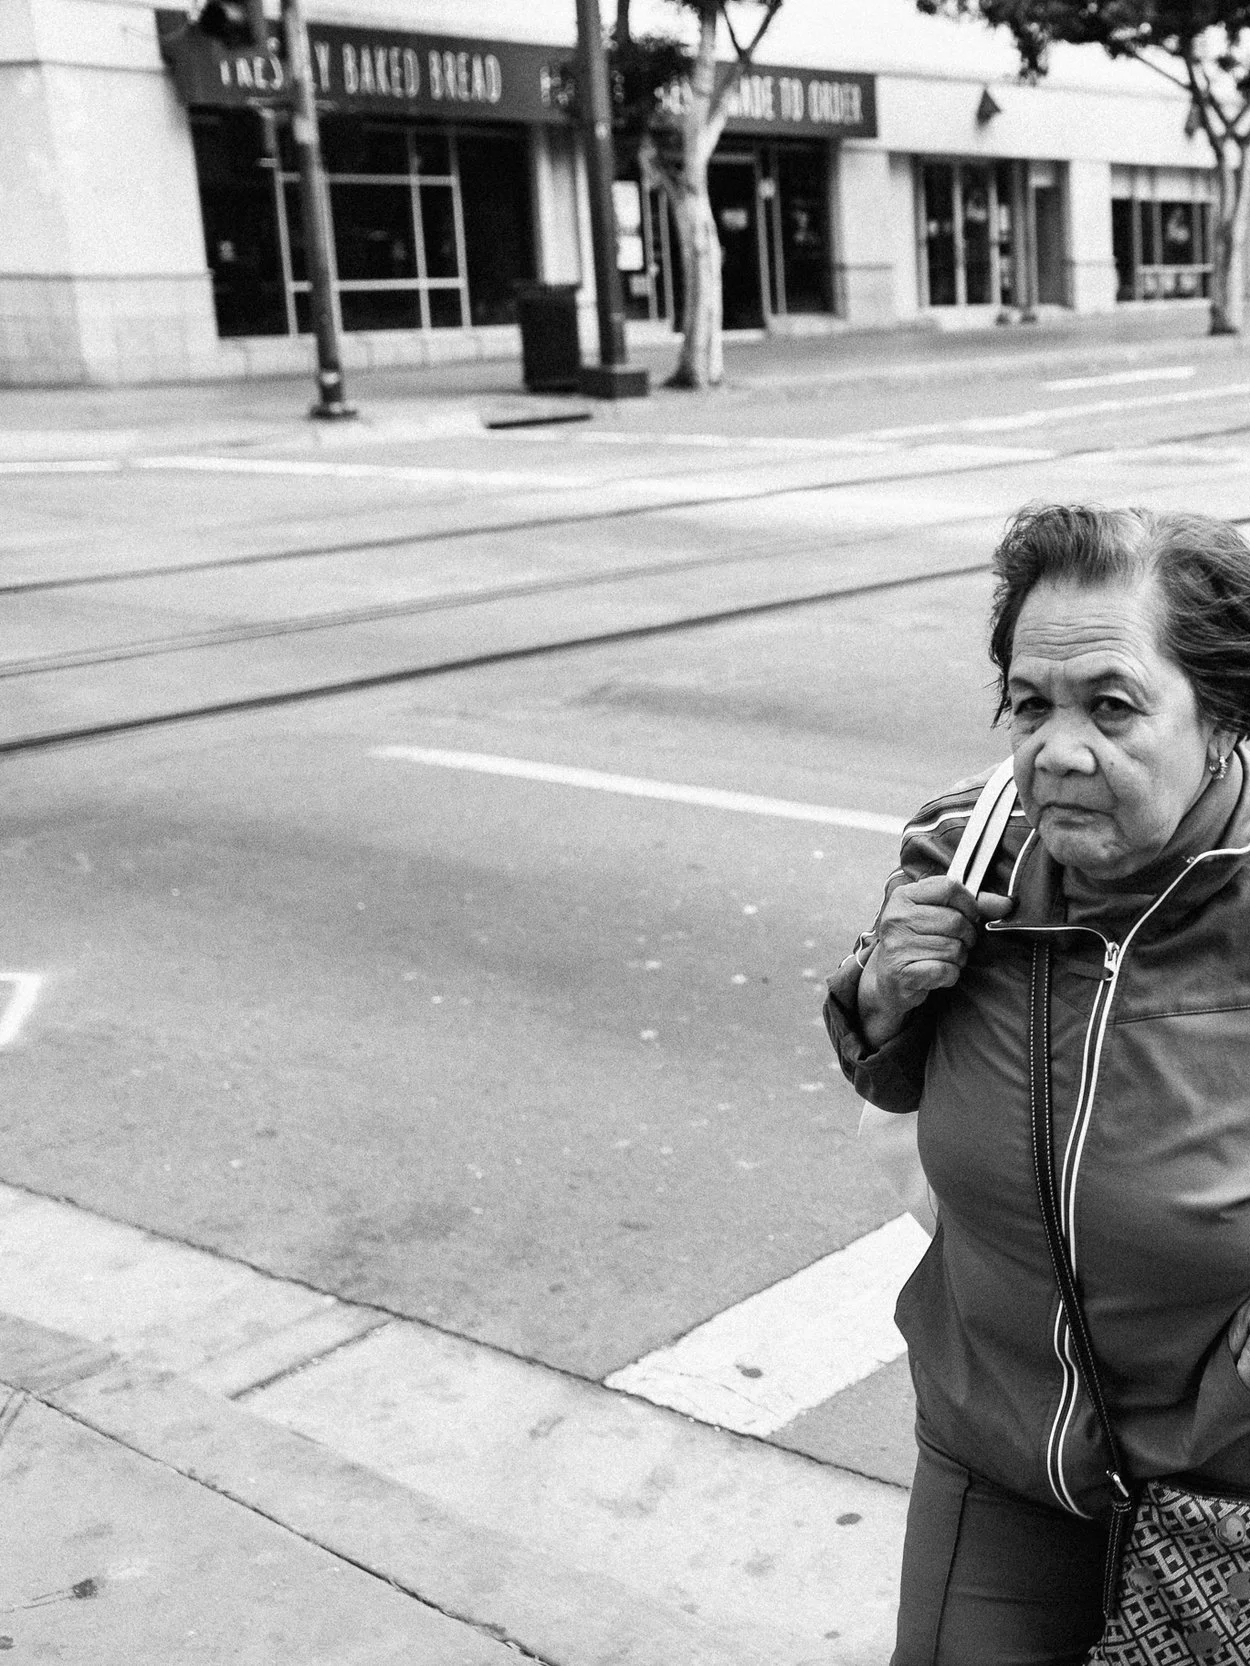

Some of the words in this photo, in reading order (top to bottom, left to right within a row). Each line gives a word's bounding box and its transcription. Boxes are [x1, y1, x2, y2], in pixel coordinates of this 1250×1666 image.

[219, 41, 330, 93] RESY
[342, 42, 421, 98] BAKED
[428, 49, 502, 103] BREAD
[779, 76, 805, 122] TO
[808, 79, 864, 125] ORDER
